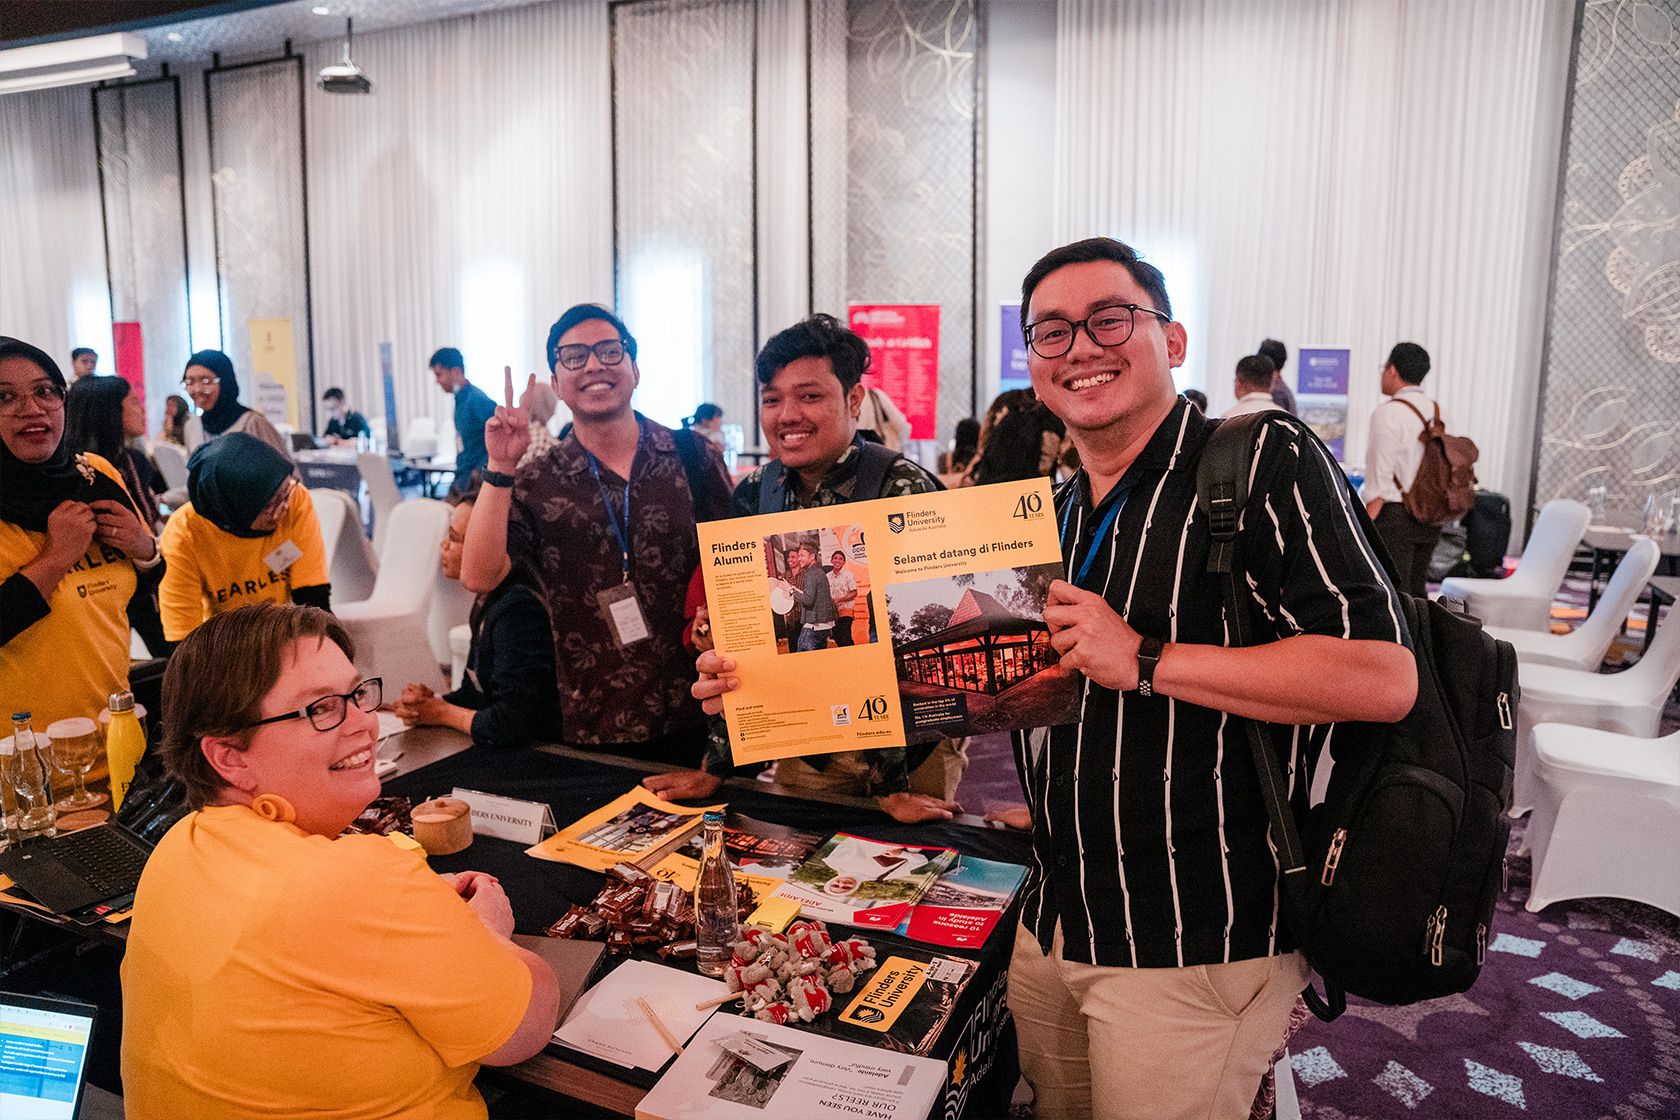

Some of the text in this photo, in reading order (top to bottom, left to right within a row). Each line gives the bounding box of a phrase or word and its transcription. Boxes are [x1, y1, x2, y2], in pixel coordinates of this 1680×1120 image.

[906, 510, 936, 518] Flinders
[1013, 493, 1042, 520] 40
[907, 516, 946, 527] University
[712, 540, 756, 554] Flinders
[894, 539, 1034, 566] Selamat datang di Flinders
[714, 552, 752, 566] Alumni
[944, 560, 967, 569] University
[858, 697, 888, 720] 40
[490, 813, 533, 828] UNIVERSITY
[949, 913, 988, 921] Adelaide
[933, 920, 968, 930] reasons
[863, 970, 900, 1004] Flinders
[878, 964, 924, 1008] University
[832, 1093, 896, 1111] OUR REELS?
[819, 1100, 892, 1120] HAVE YOU SEEN
